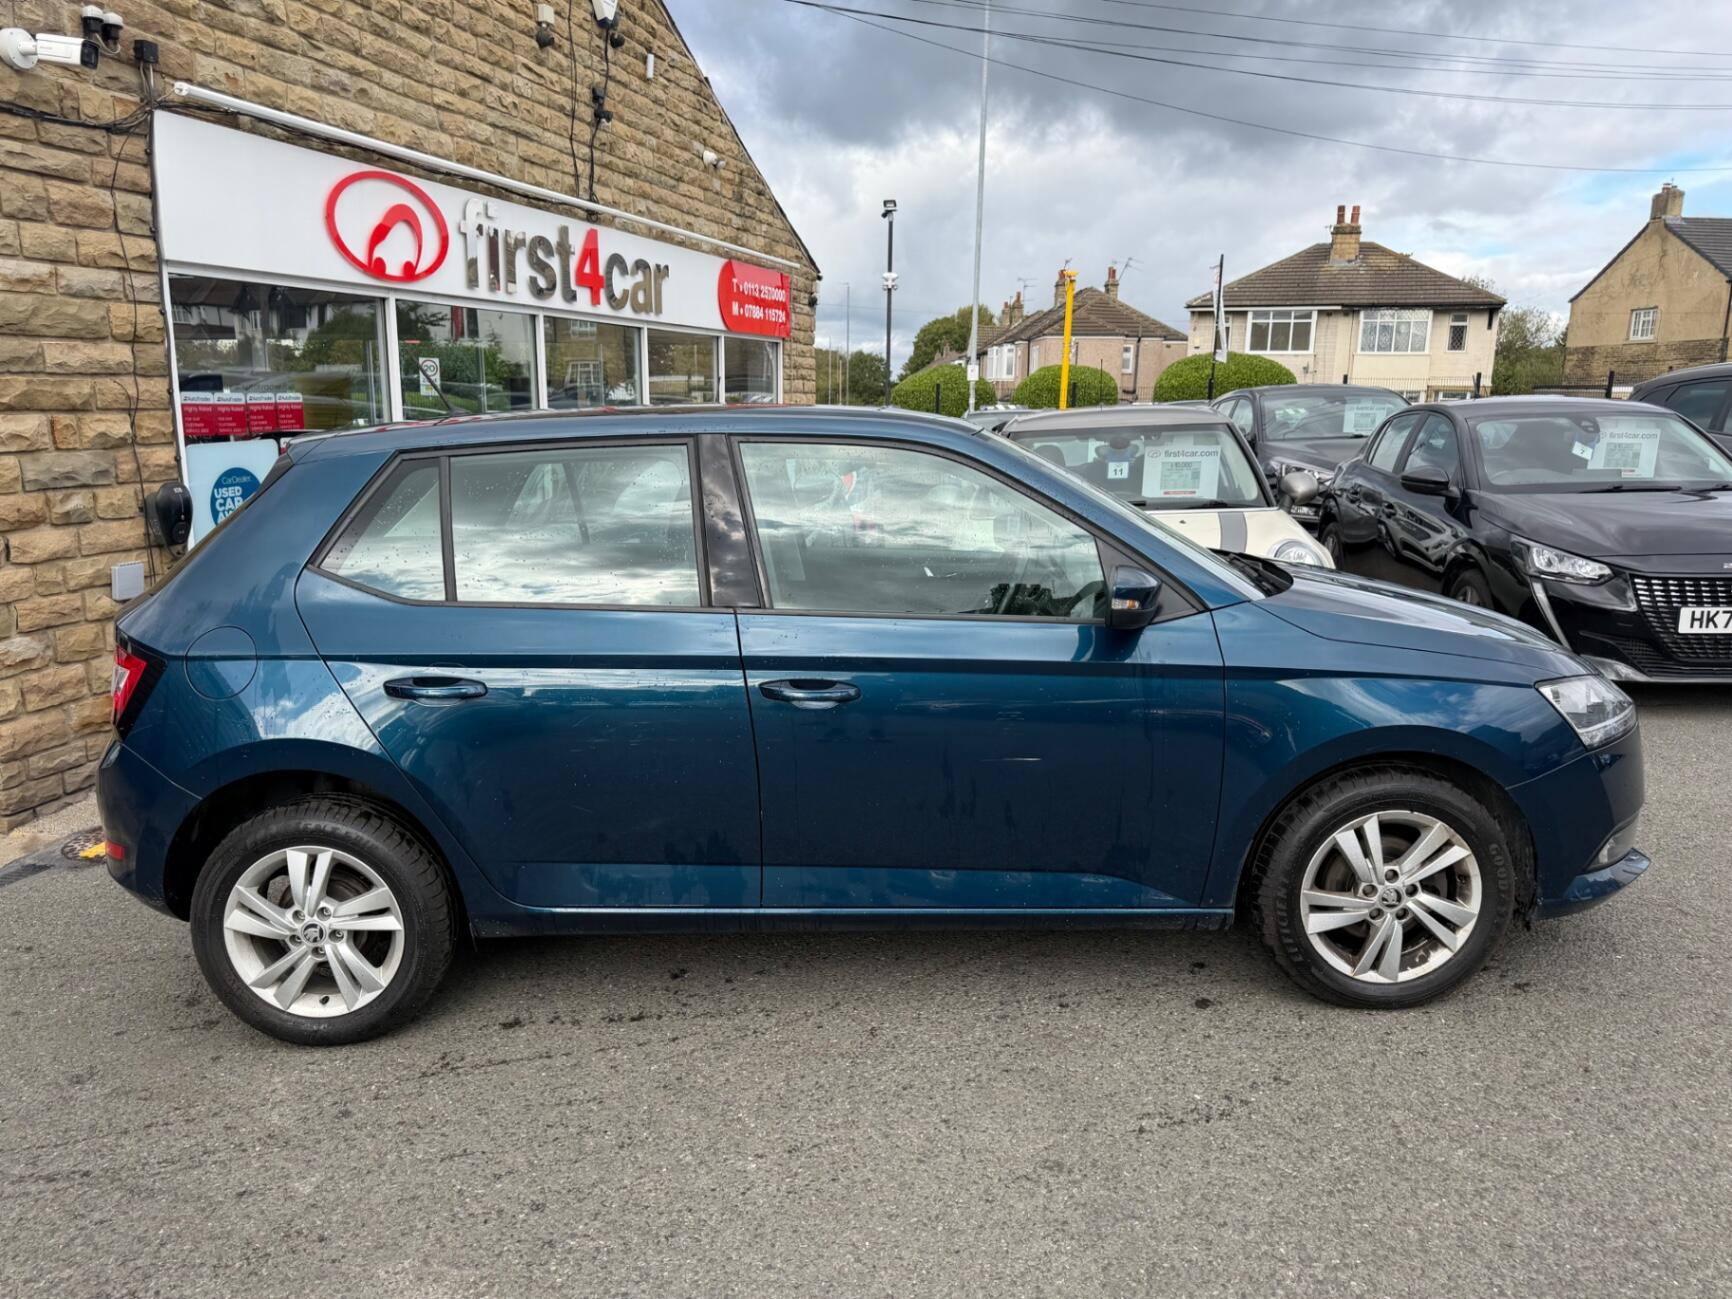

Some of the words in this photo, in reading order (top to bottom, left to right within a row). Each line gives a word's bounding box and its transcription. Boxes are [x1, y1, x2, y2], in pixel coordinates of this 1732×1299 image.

[459, 198, 670, 316] first4car
[732, 278, 738, 293] T
[743, 281, 760, 298] 0113
[732, 301, 739, 316] M
[1164, 449, 1219, 459] first4car.com
[1113, 468, 1124, 476] 11
[214, 486, 243, 499] USED
[215, 497, 244, 512] CAR
